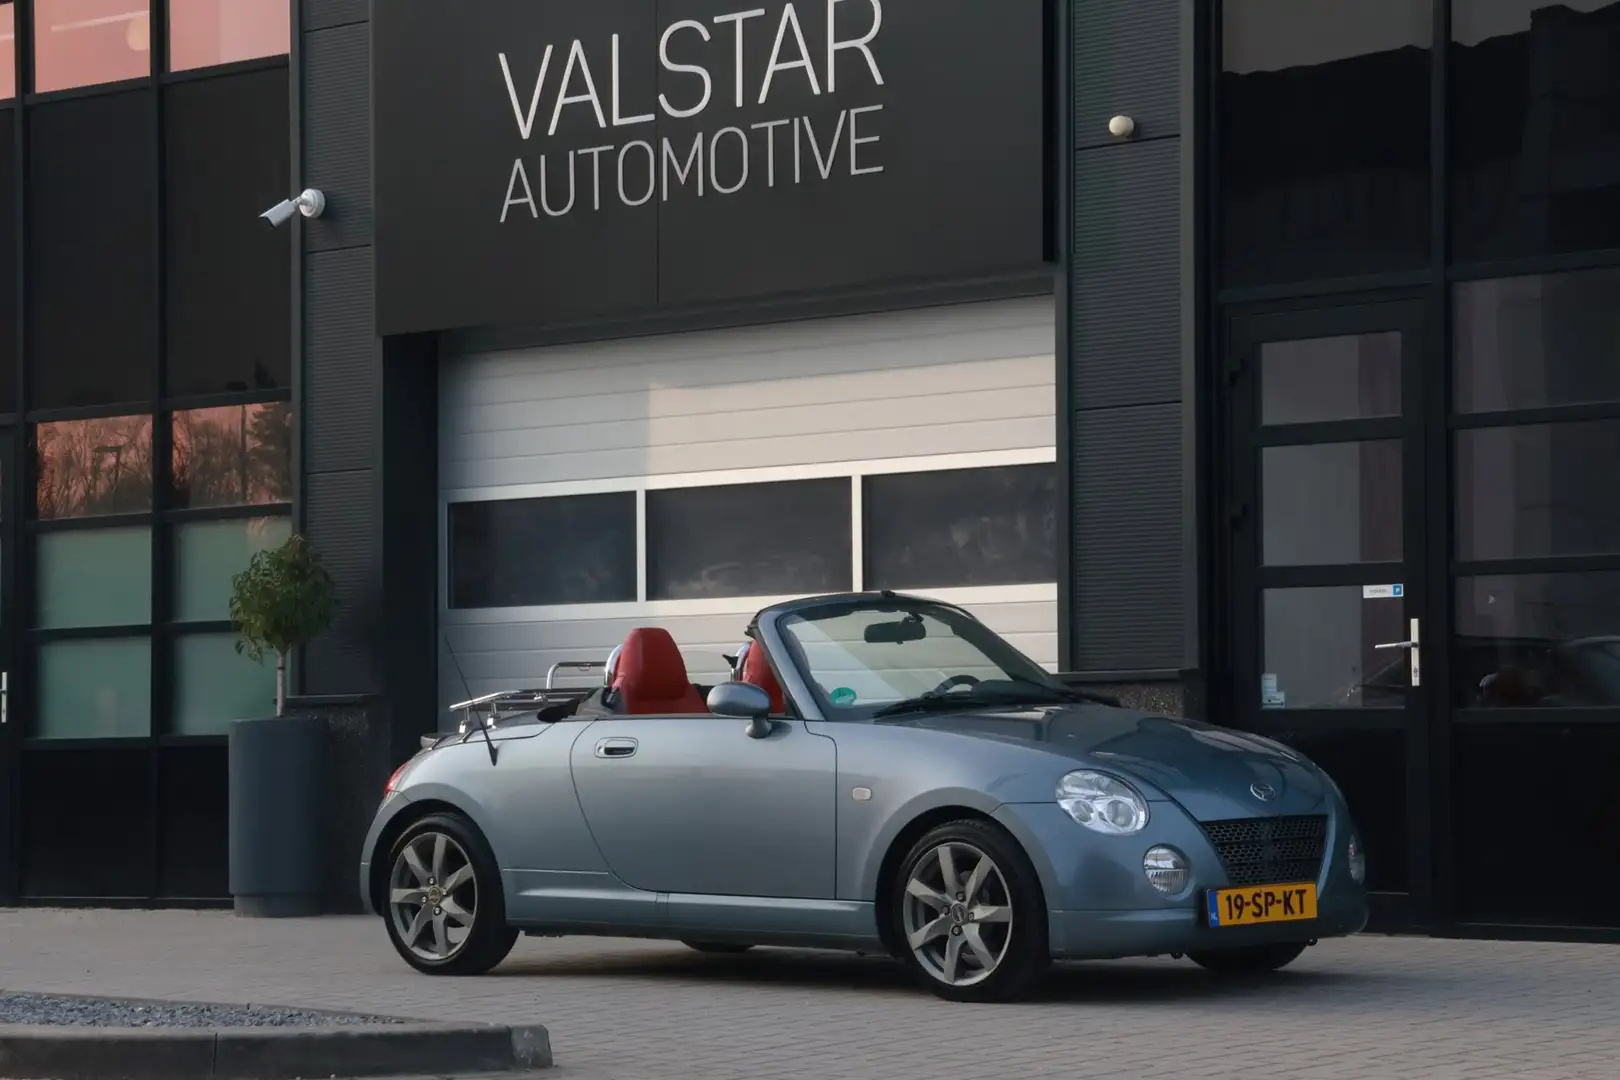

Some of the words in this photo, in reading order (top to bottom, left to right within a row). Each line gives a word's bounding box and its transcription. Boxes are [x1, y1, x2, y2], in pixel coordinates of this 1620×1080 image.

[498, 0, 884, 139] VALSTAR
[499, 104, 884, 223] AUTOMOTIVE
[1225, 889, 1307, 920] 19-SP-KT
